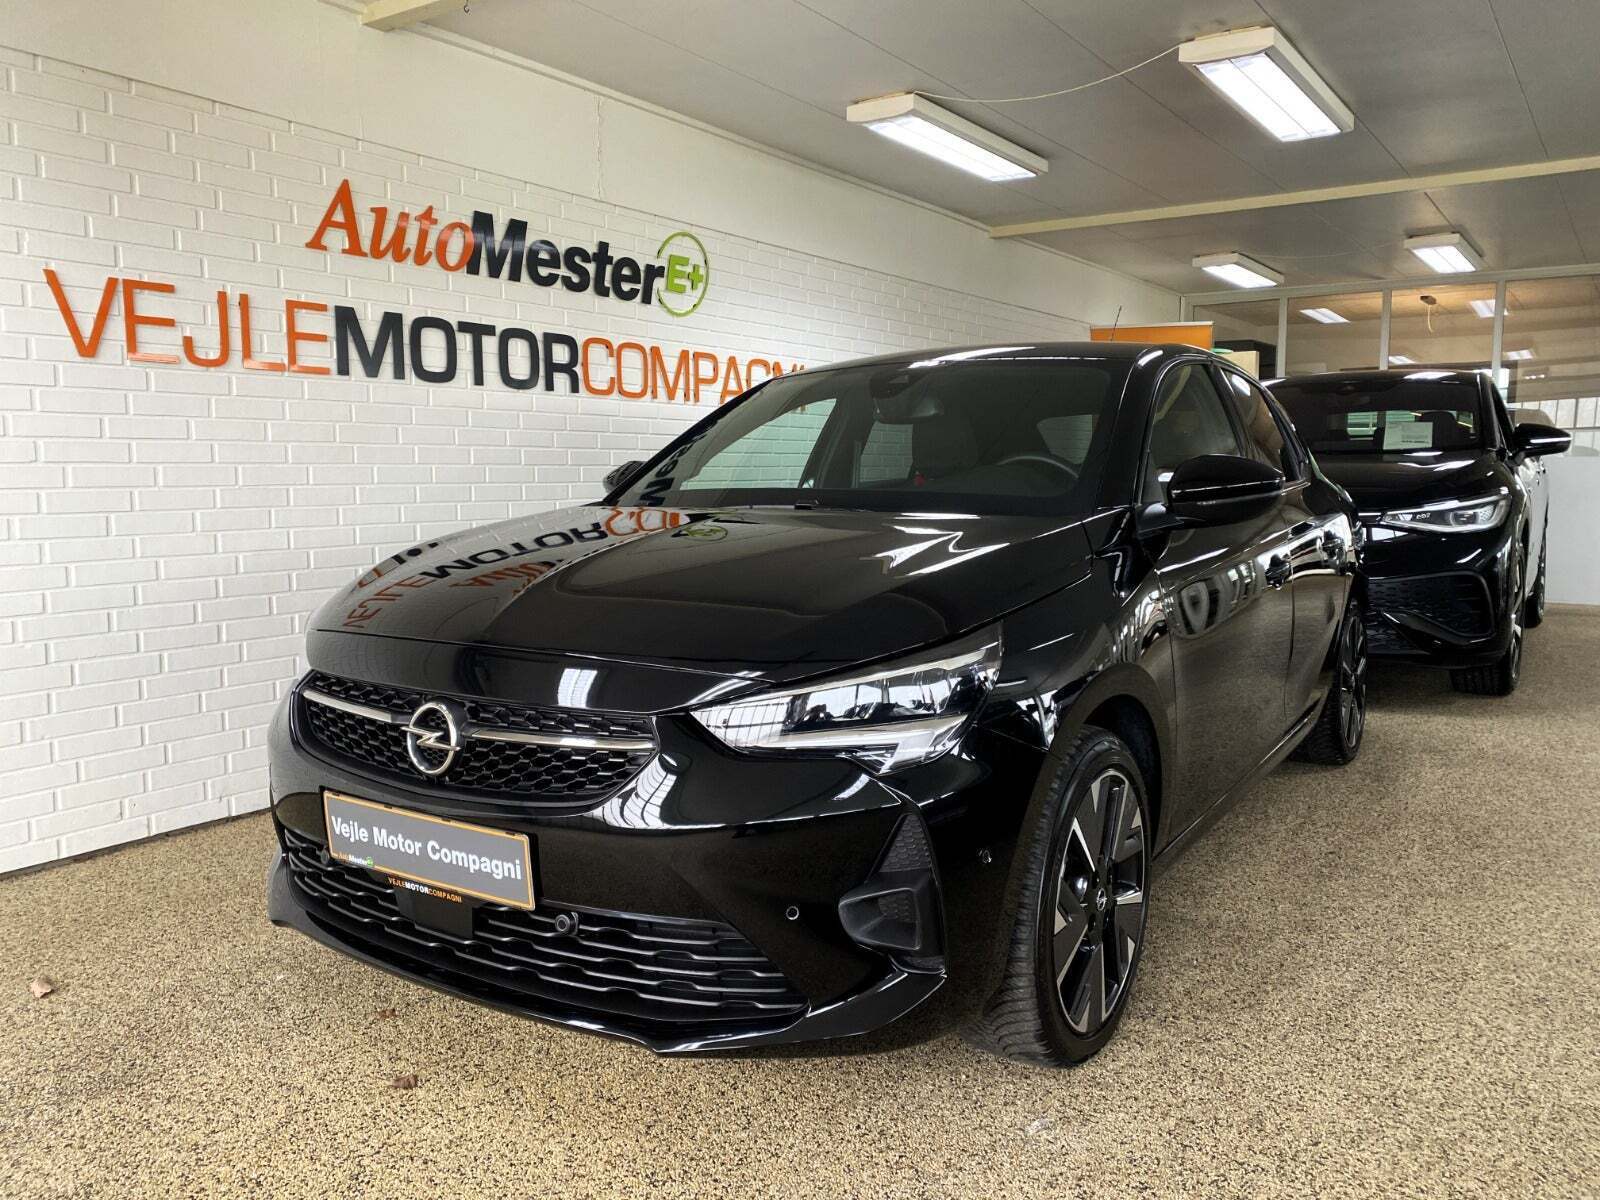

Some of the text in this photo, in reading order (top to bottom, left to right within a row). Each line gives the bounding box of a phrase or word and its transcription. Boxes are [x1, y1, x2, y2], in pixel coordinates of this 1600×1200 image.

[305, 178, 665, 304] AutoMester
[43, 268, 805, 406] VEJLEMOTORCOMPA
[331, 815, 523, 880] Vejle Motor Compagni
[387, 876, 463, 904] VEJLEMOTORCOMPAGNI
